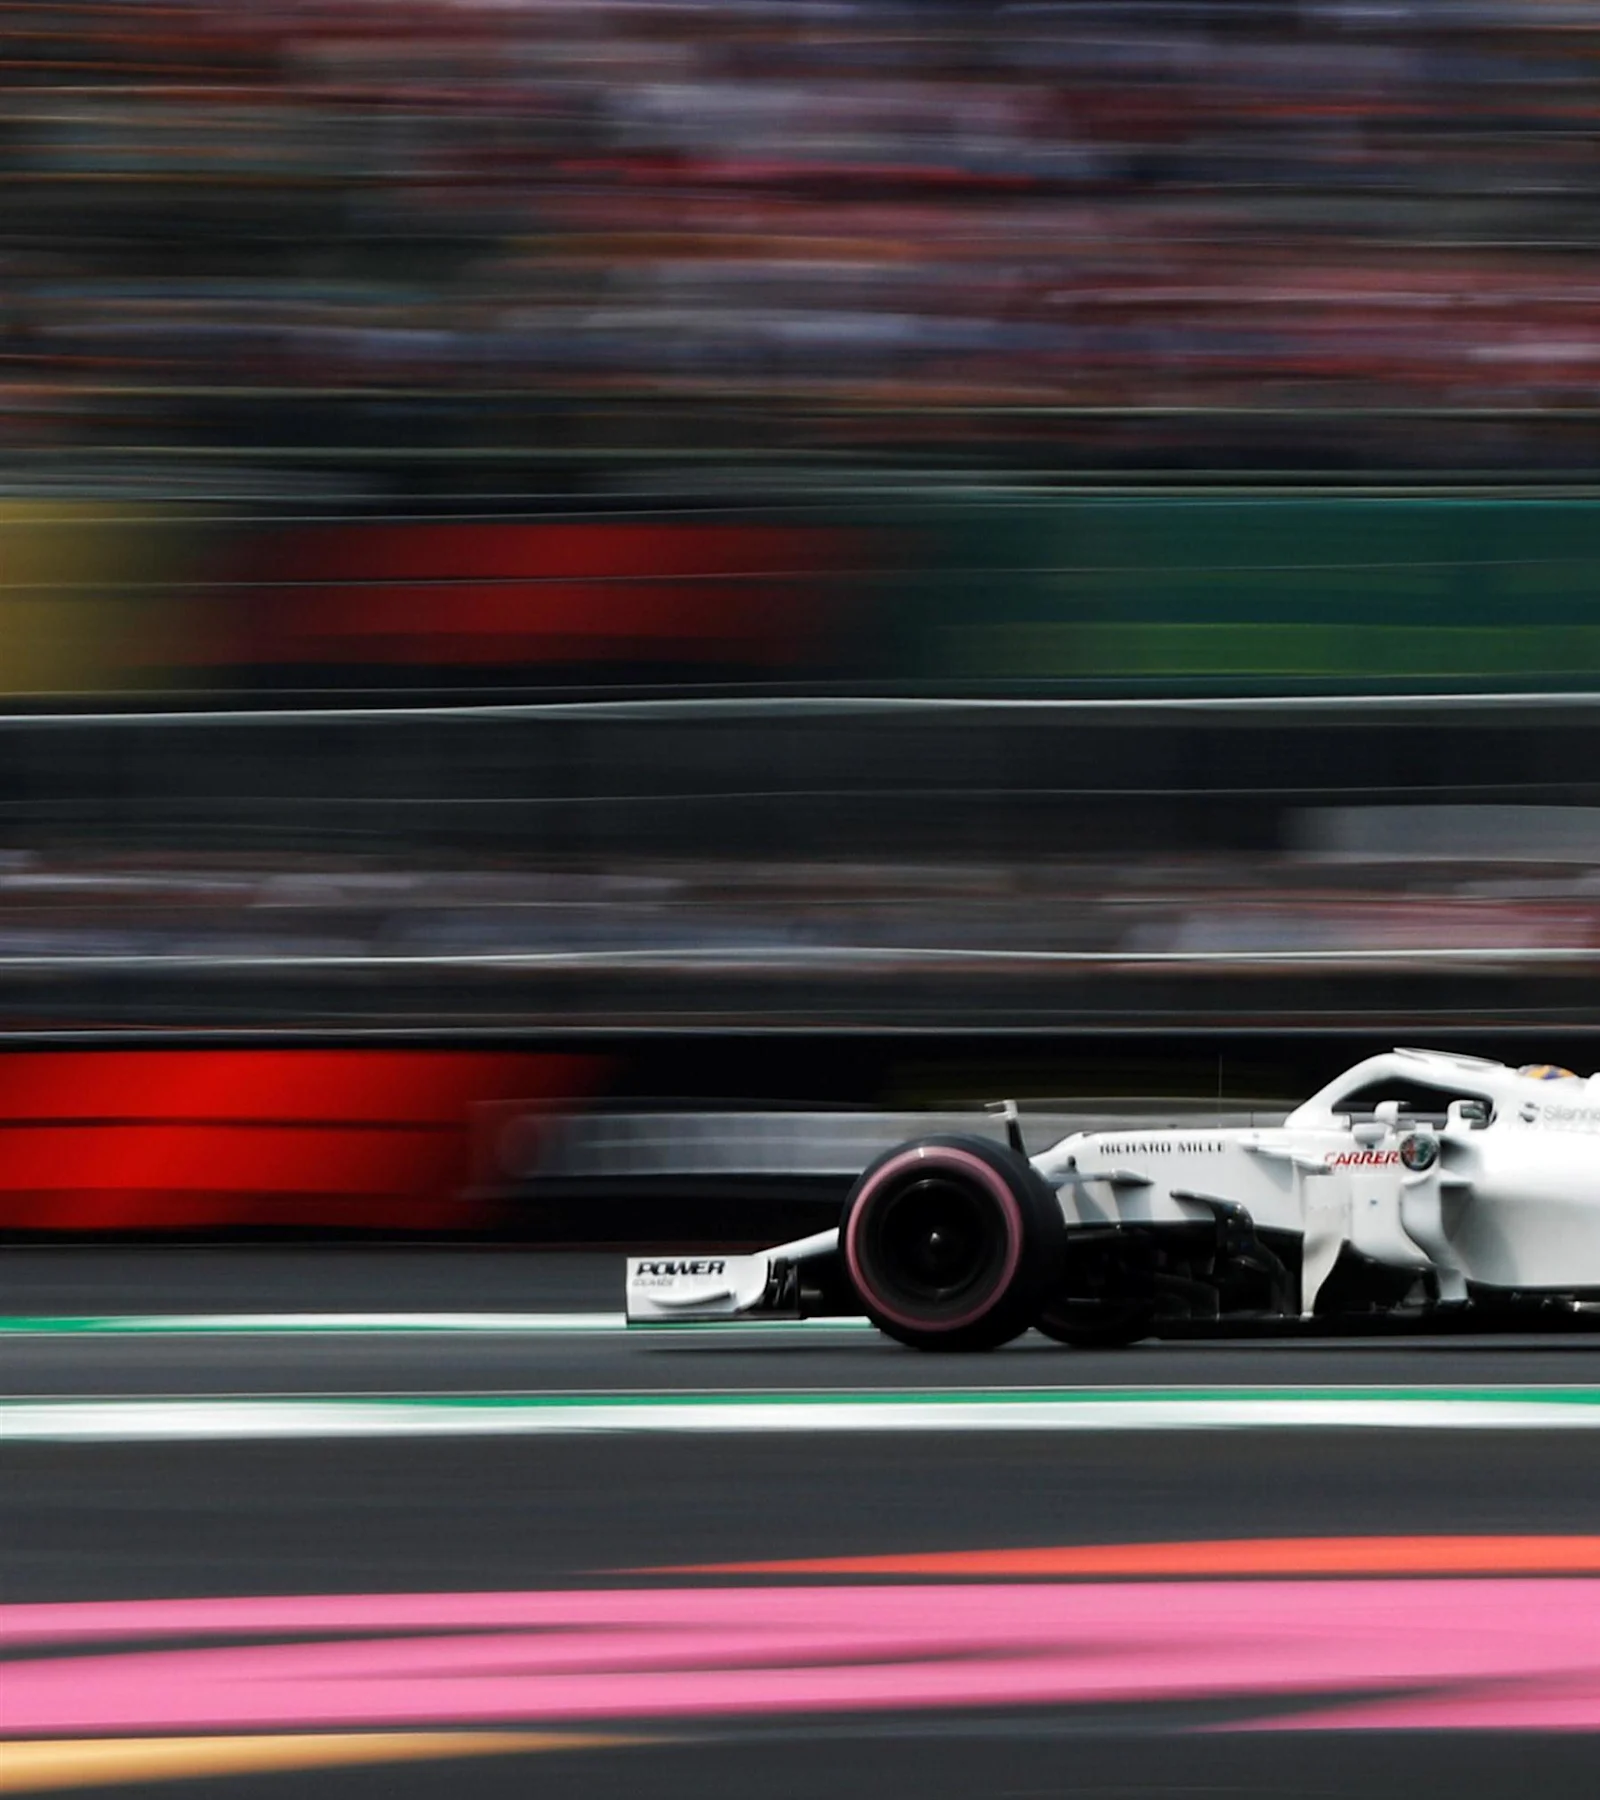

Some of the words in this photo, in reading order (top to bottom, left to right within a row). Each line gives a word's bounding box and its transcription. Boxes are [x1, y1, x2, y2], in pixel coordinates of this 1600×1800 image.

[1099, 1142, 1171, 1154] RICHARD
[1178, 1142, 1224, 1153] MILLE
[637, 1261, 725, 1275] POWER
